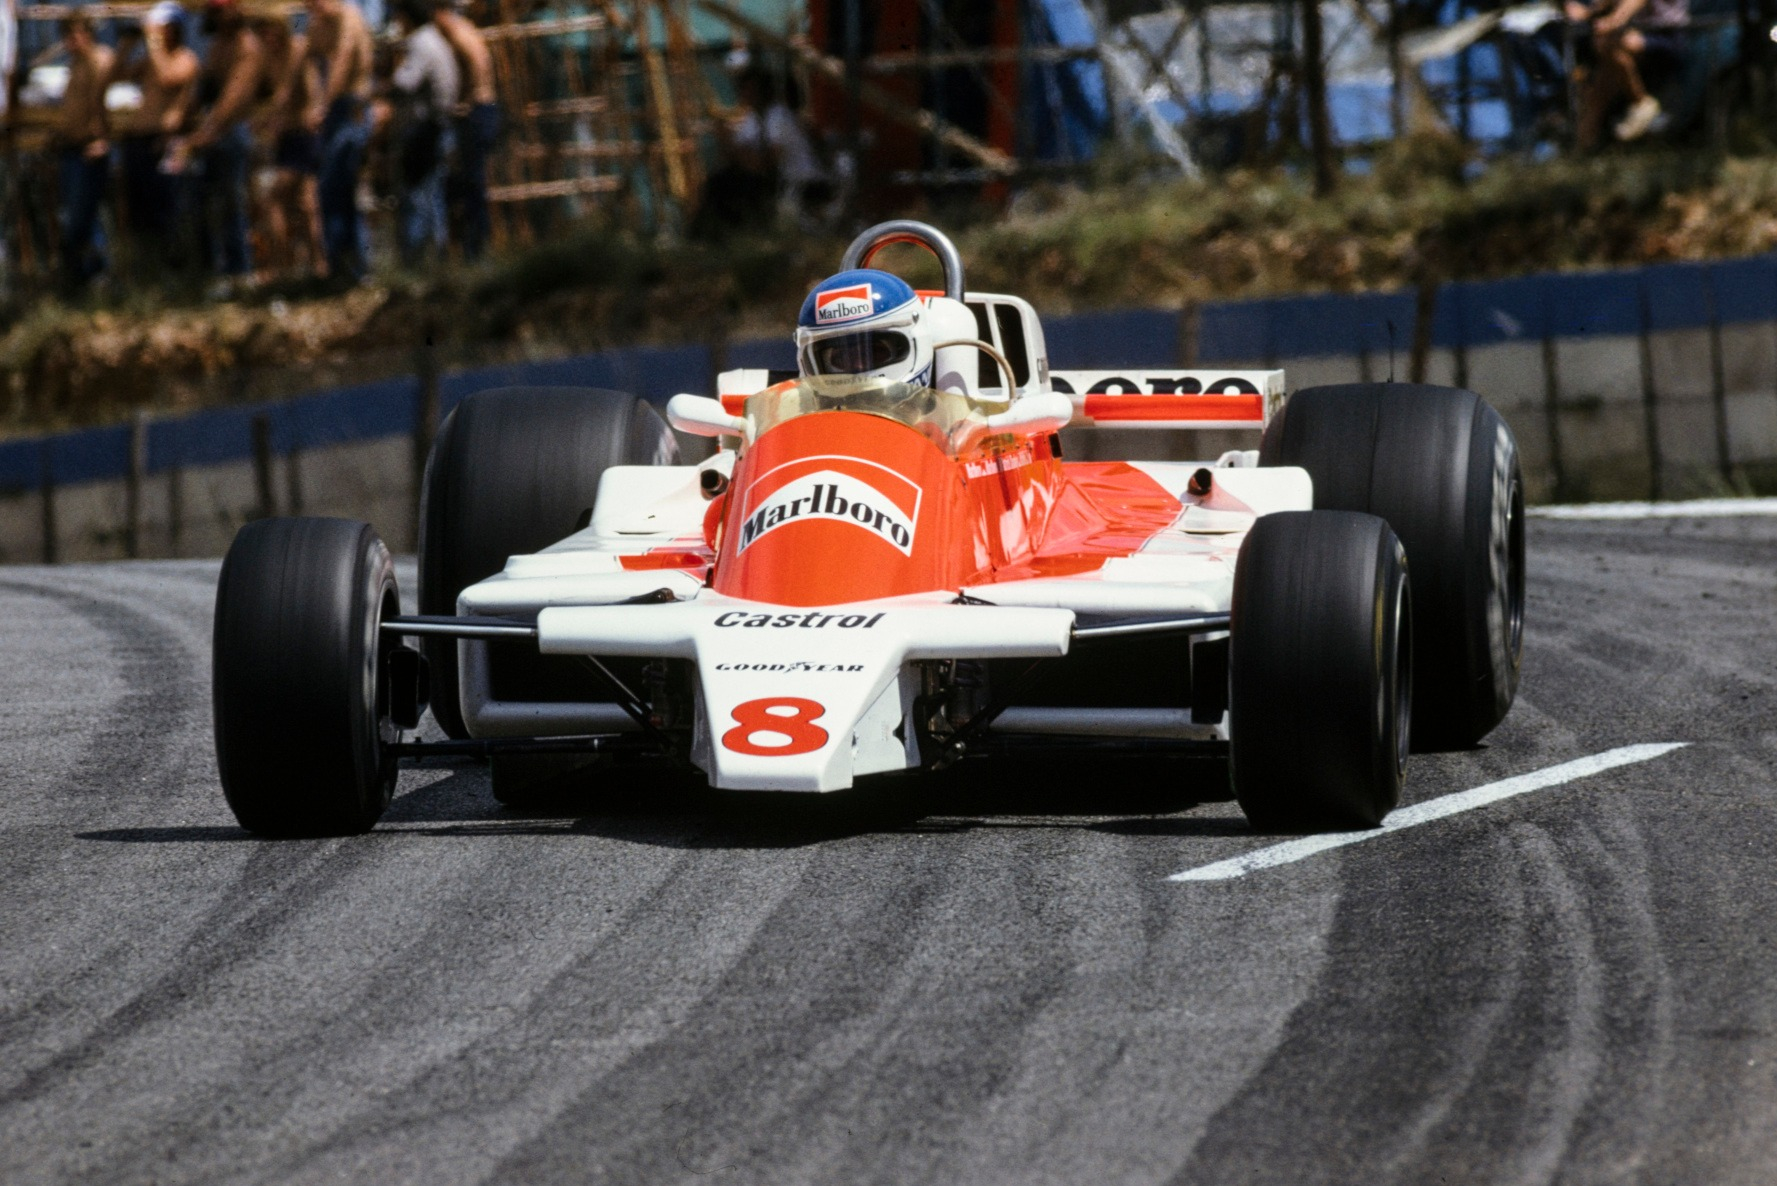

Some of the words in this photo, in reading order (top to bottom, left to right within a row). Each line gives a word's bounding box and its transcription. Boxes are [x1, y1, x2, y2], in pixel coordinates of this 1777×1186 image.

[818, 302, 870, 321] Marlboro
[741, 483, 910, 550] Marlboro
[713, 611, 887, 629] Castrol
[715, 661, 865, 674] GOODYEAR
[721, 696, 829, 757] 8
